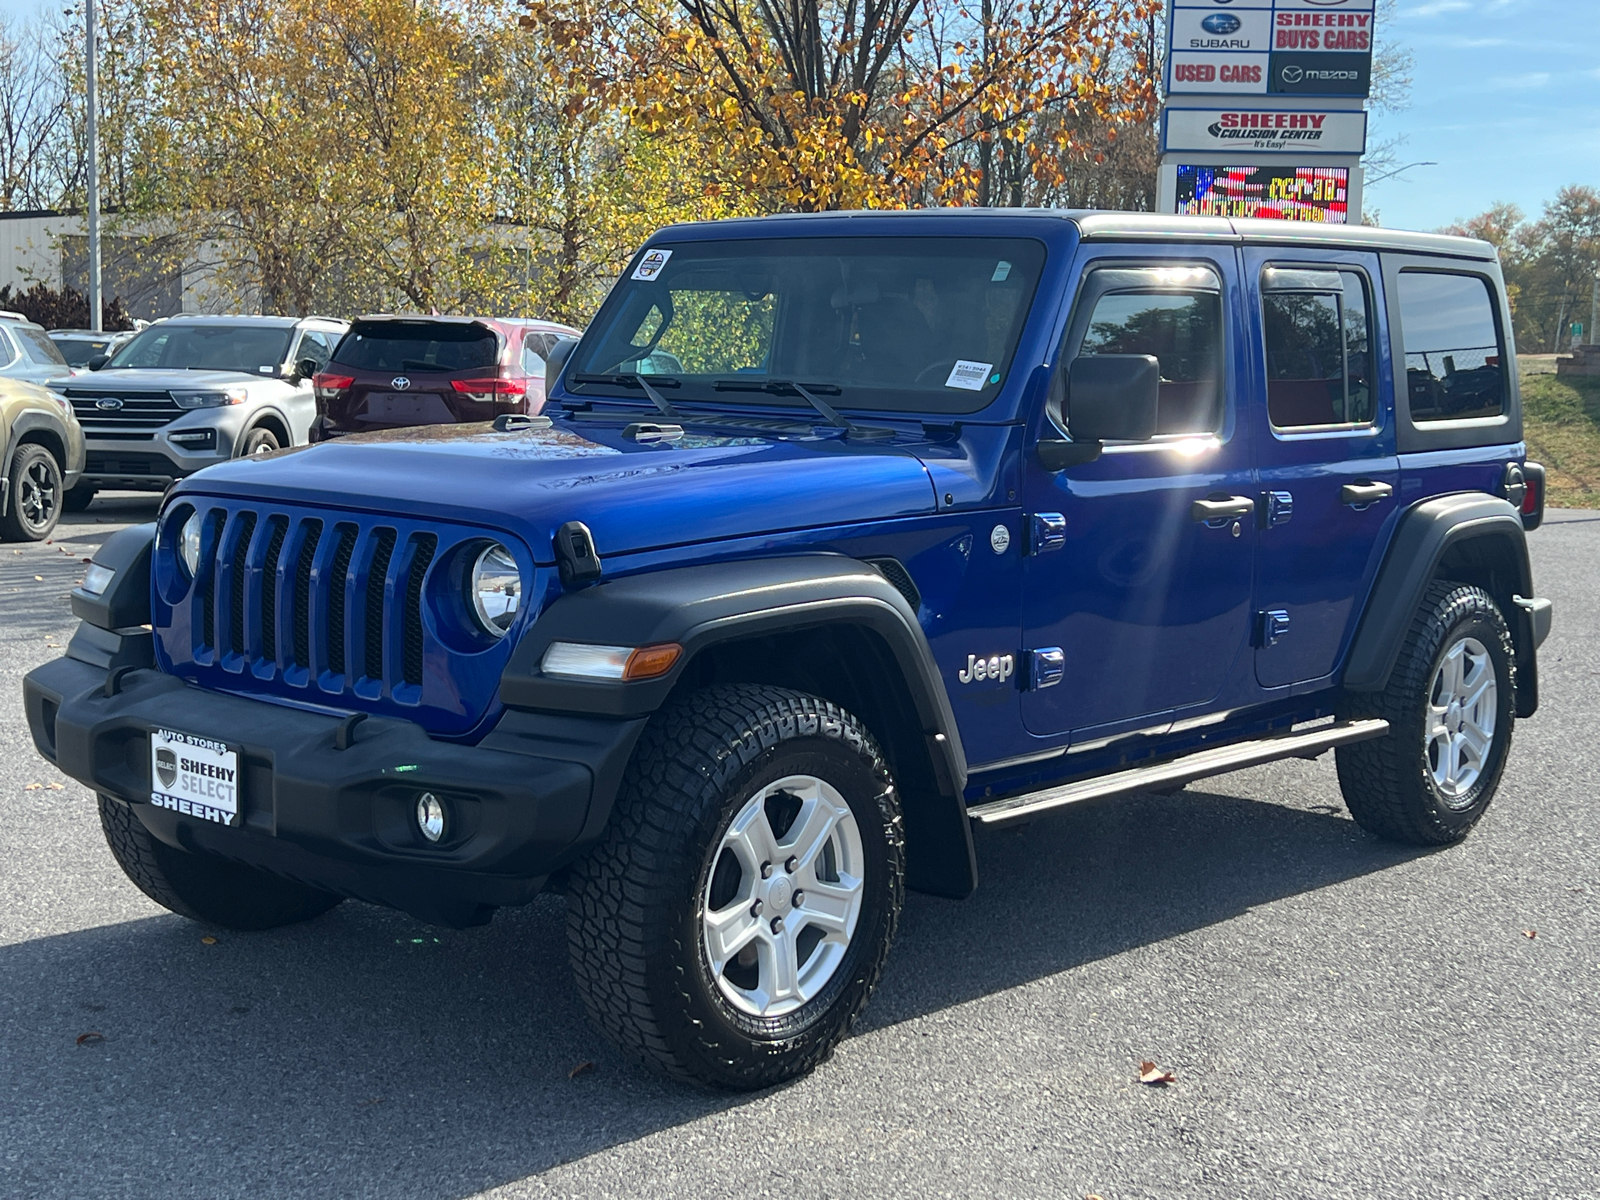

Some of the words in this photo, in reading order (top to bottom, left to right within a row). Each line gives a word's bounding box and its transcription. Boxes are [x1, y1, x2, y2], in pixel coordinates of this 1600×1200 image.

[1276, 13, 1370, 27] SHEEHY
[1190, 39, 1250, 49] SUBARU
[1275, 30, 1320, 49] BUYS
[1323, 30, 1369, 50] CARS
[1175, 64, 1216, 82] USED
[1219, 64, 1262, 83] CARS
[1220, 113, 1326, 129] SHEEHY
[1220, 129, 1279, 140] COLLISION
[1279, 130, 1323, 140] CENTER
[1254, 140, 1270, 149] It's
[1271, 140, 1286, 150] Easy!
[959, 654, 1014, 684] Jeep
[158, 729, 185, 742] AUTO
[186, 736, 227, 752] STORES
[180, 758, 235, 782] SHEEHY
[181, 774, 235, 802] SELECT
[151, 792, 235, 826] SHEEHY
